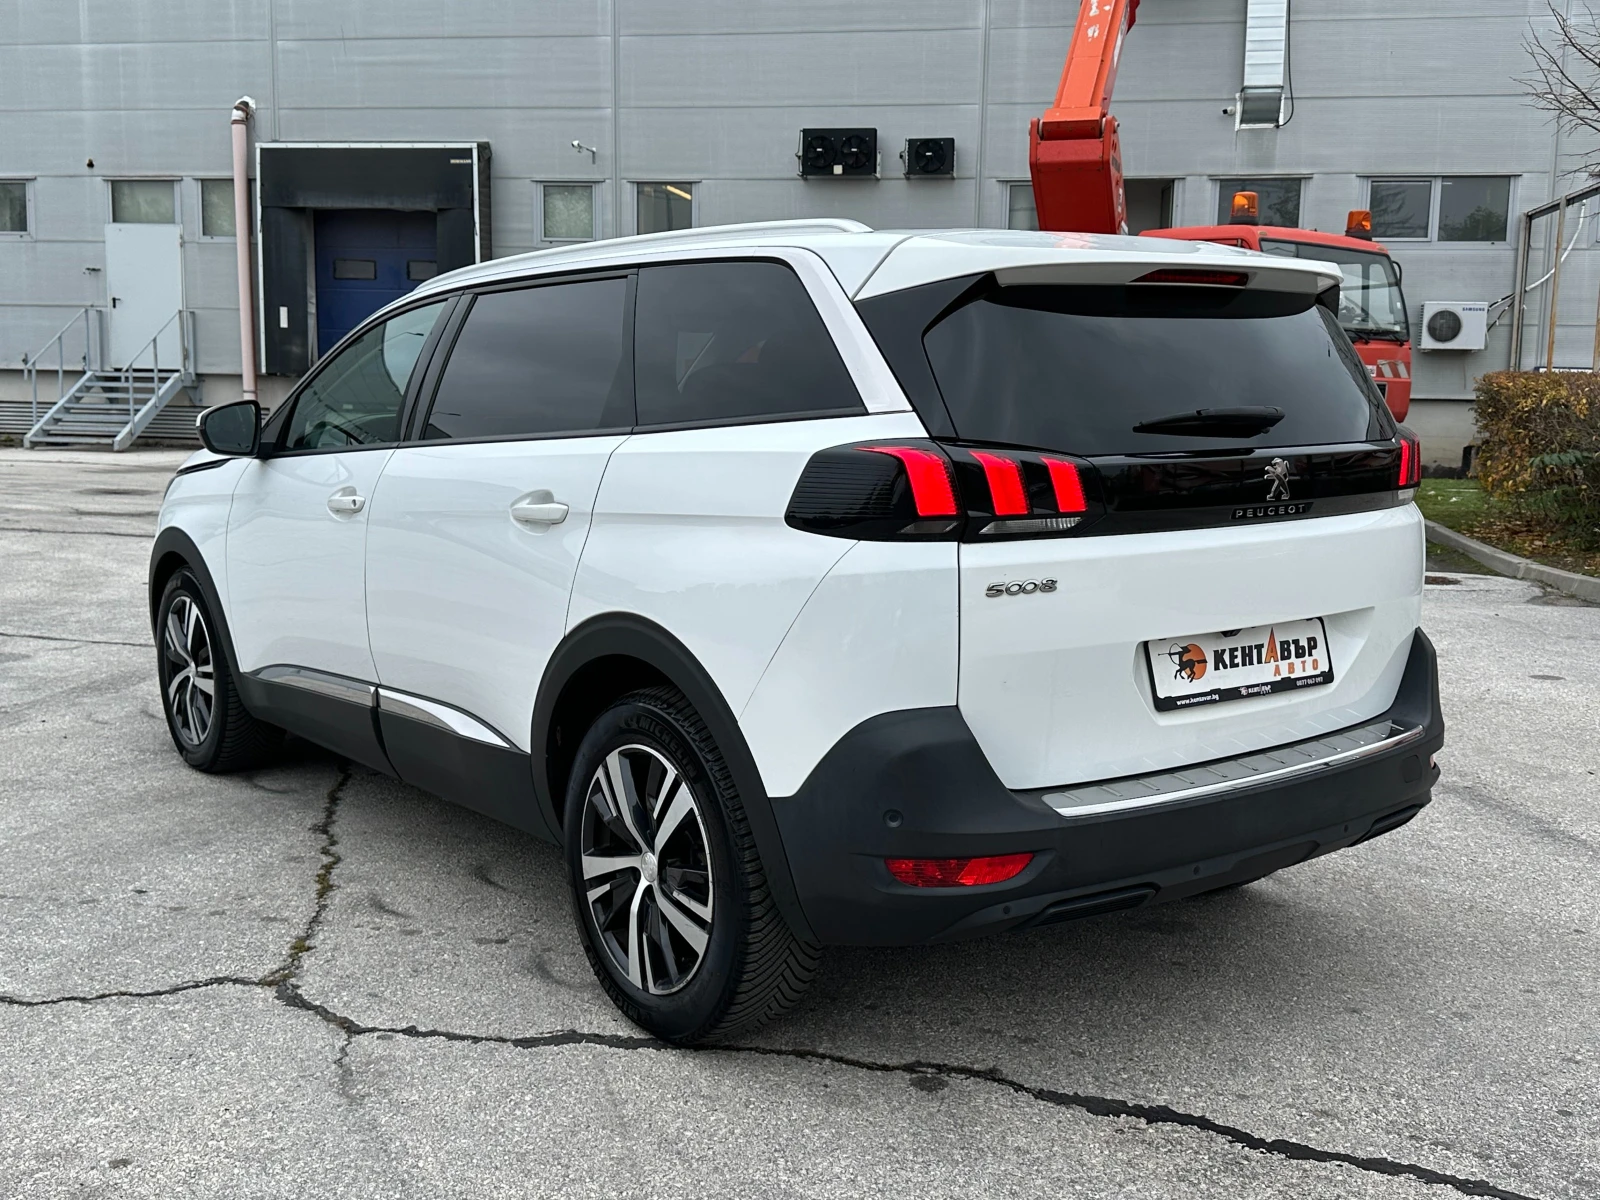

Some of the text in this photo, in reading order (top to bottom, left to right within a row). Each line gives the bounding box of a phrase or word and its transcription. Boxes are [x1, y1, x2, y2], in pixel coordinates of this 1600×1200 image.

[1235, 504, 1306, 519] PEUGEOT
[985, 577, 1059, 598] 5008
[1213, 626, 1318, 672] КЕНТАВЪР
[1273, 658, 1320, 677] АВТО
[638, 716, 698, 778] MICHELIN
